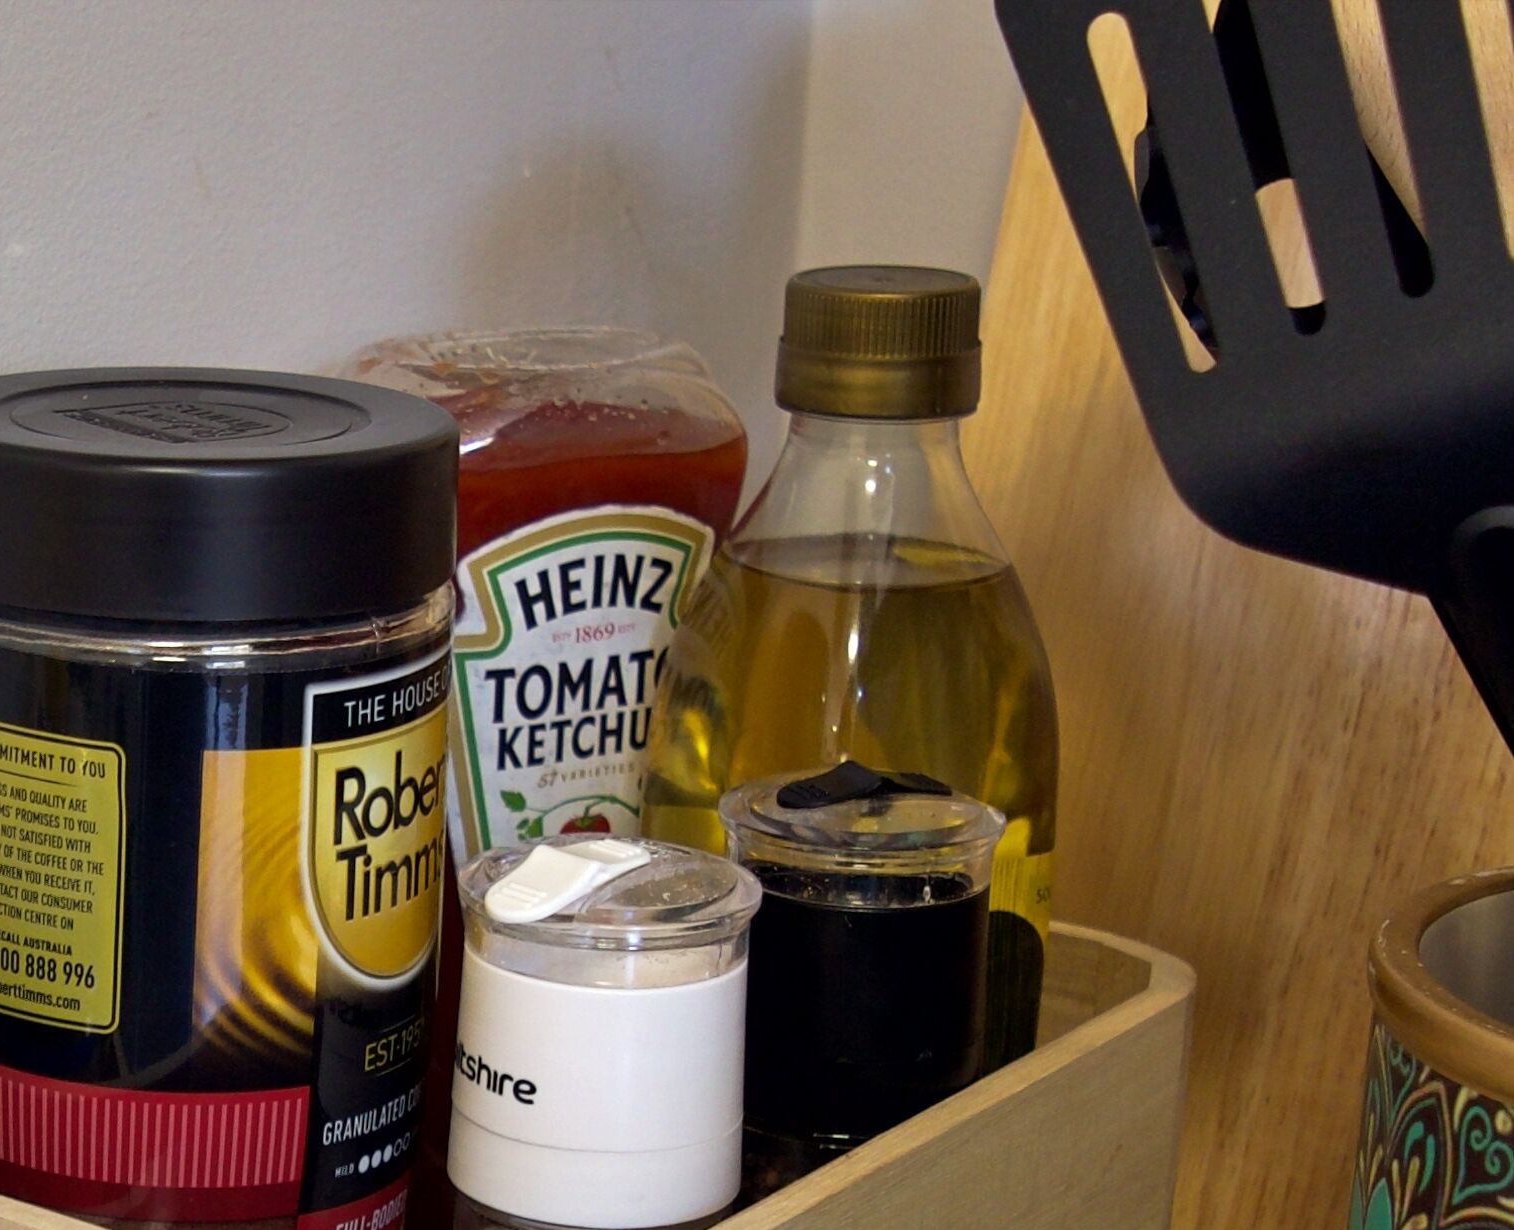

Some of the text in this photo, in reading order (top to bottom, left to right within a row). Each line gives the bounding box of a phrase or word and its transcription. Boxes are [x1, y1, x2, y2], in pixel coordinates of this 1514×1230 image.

[514, 554, 673, 631] HEINZ
[576, 623, 615, 643] 1869
[343, 694, 386, 728] THE
[392, 671, 440, 717] HOUSE
[497, 707, 652, 771] KETCHU
[60, 756, 76, 774] TO
[81, 760, 105, 778] YOU
[9, 787, 27, 802] AND
[29, 791, 66, 809] QUALITY
[68, 798, 88, 812] ARE
[333, 750, 446, 846] Rober
[15, 807, 60, 829] PROMISES
[63, 818, 75, 831] TO
[0, 824, 17, 839] NOT
[19, 828, 63, 850] SATISFIED
[65, 837, 91, 854] WITH
[3, 844, 14, 858] OF
[16, 847, 32, 865] THE
[35, 852, 68, 871] COFFEE
[69, 858, 83, 873] OR
[87, 860, 105, 876] THE
[24, 870, 41, 885] YOU
[43, 874, 82, 892] RECEIVE
[20, 888, 39, 905] OUR
[41, 893, 93, 914] CONSUMER
[24, 909, 58, 929] CENTRE
[60, 916, 74, 931] ON
[23, 937, 73, 956] AUSTRALIA
[25, 954, 57, 983] 888
[63, 961, 96, 989] 996
[455, 1041, 537, 1105] tshire
[322, 1093, 406, 1147] GRANULATED
